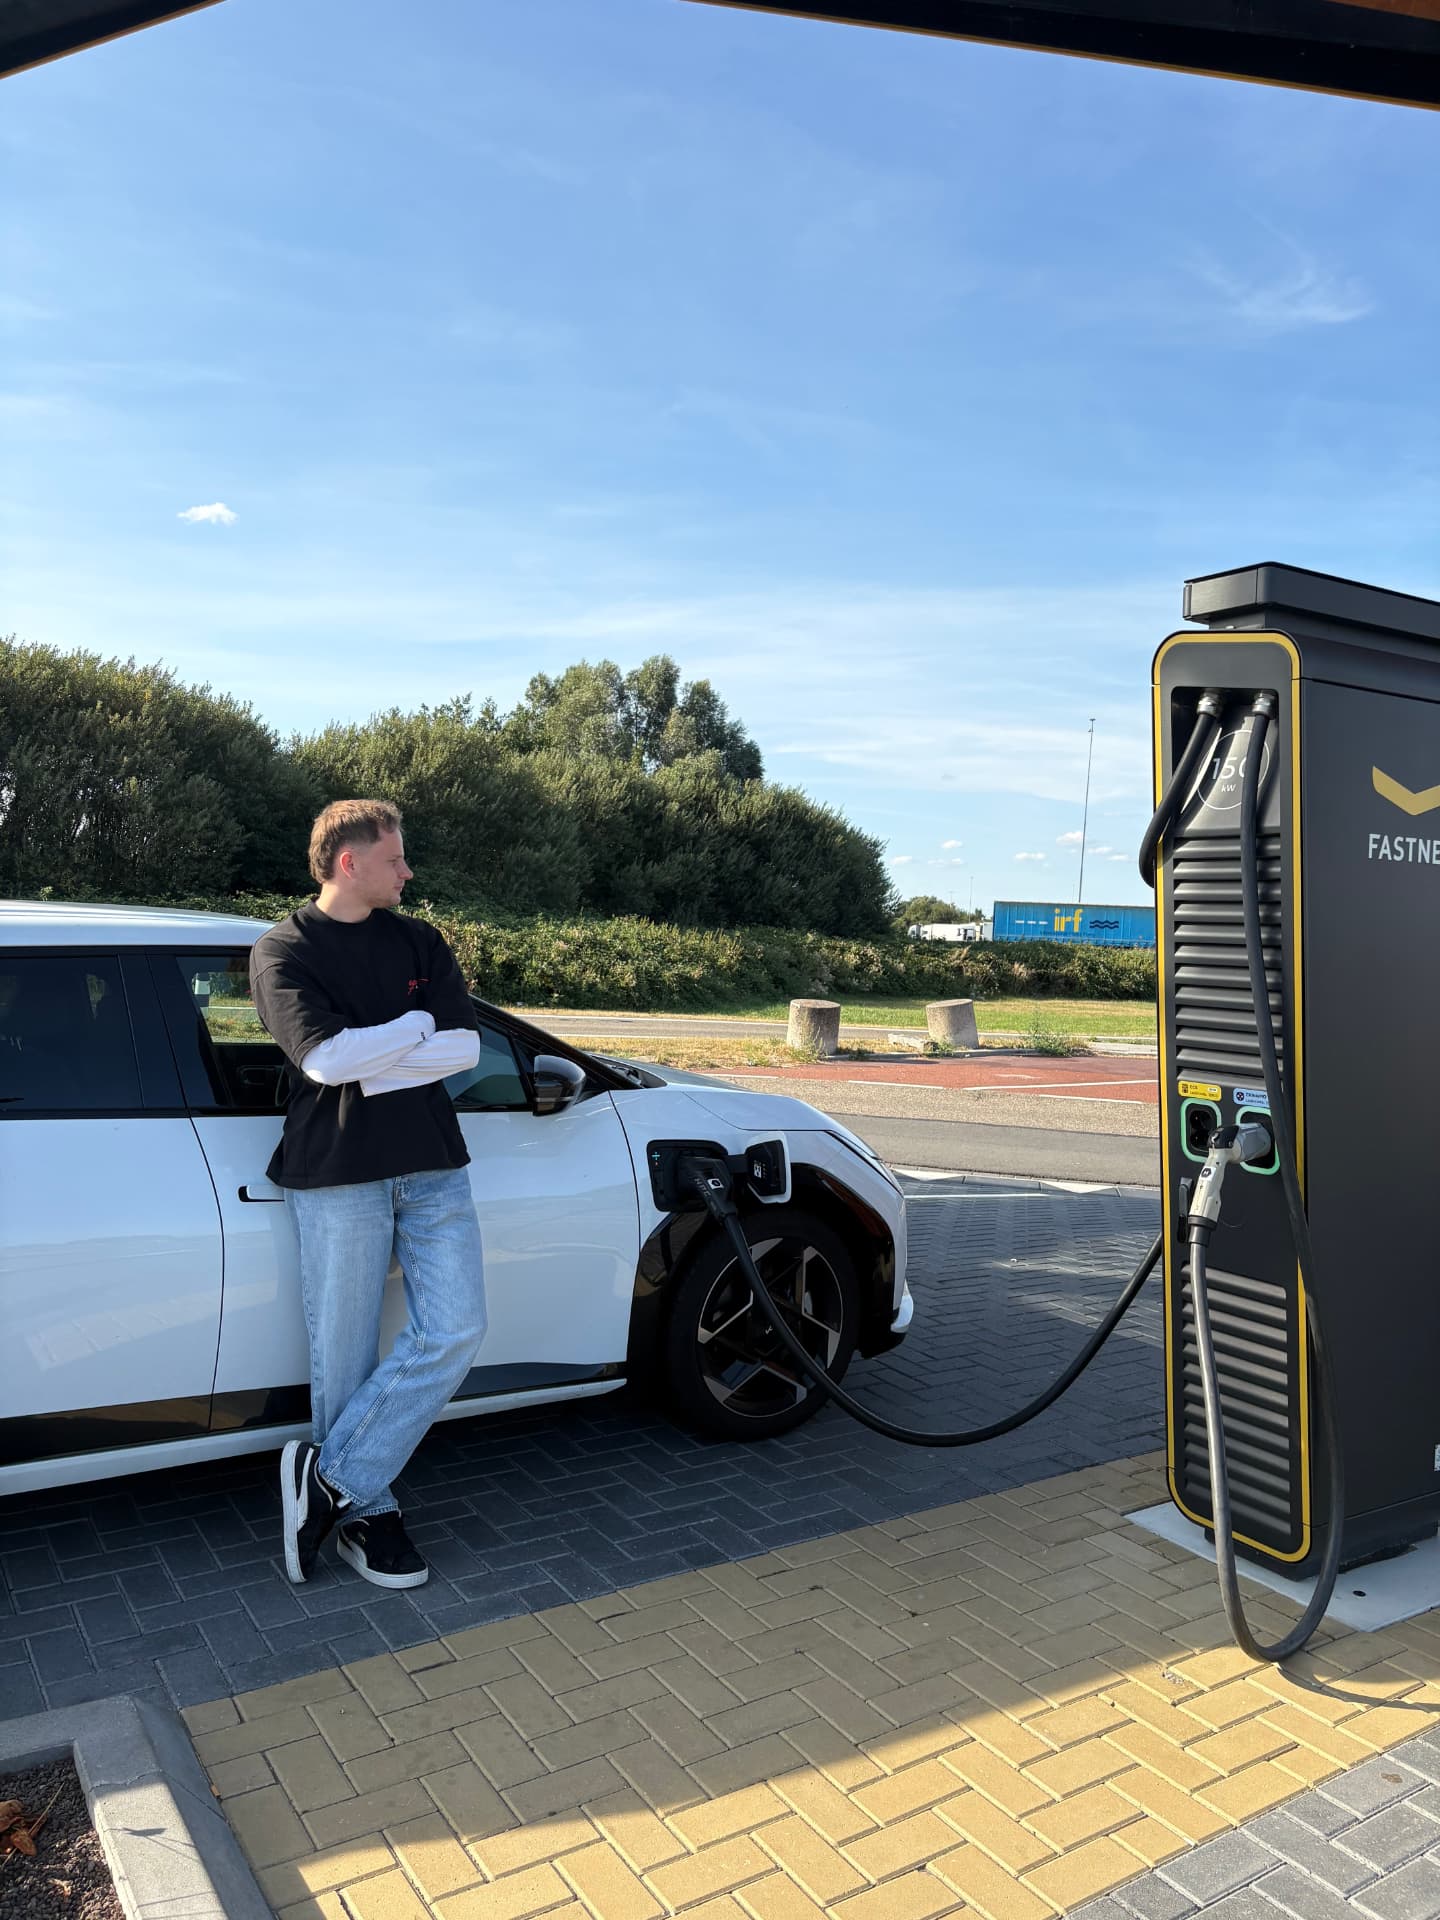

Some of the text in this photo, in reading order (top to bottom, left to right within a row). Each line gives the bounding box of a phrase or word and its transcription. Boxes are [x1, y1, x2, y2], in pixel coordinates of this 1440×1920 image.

[1221, 784, 1236, 792] kW
[1368, 833, 1440, 865] FASTNE
[1054, 907, 1083, 933] irf
